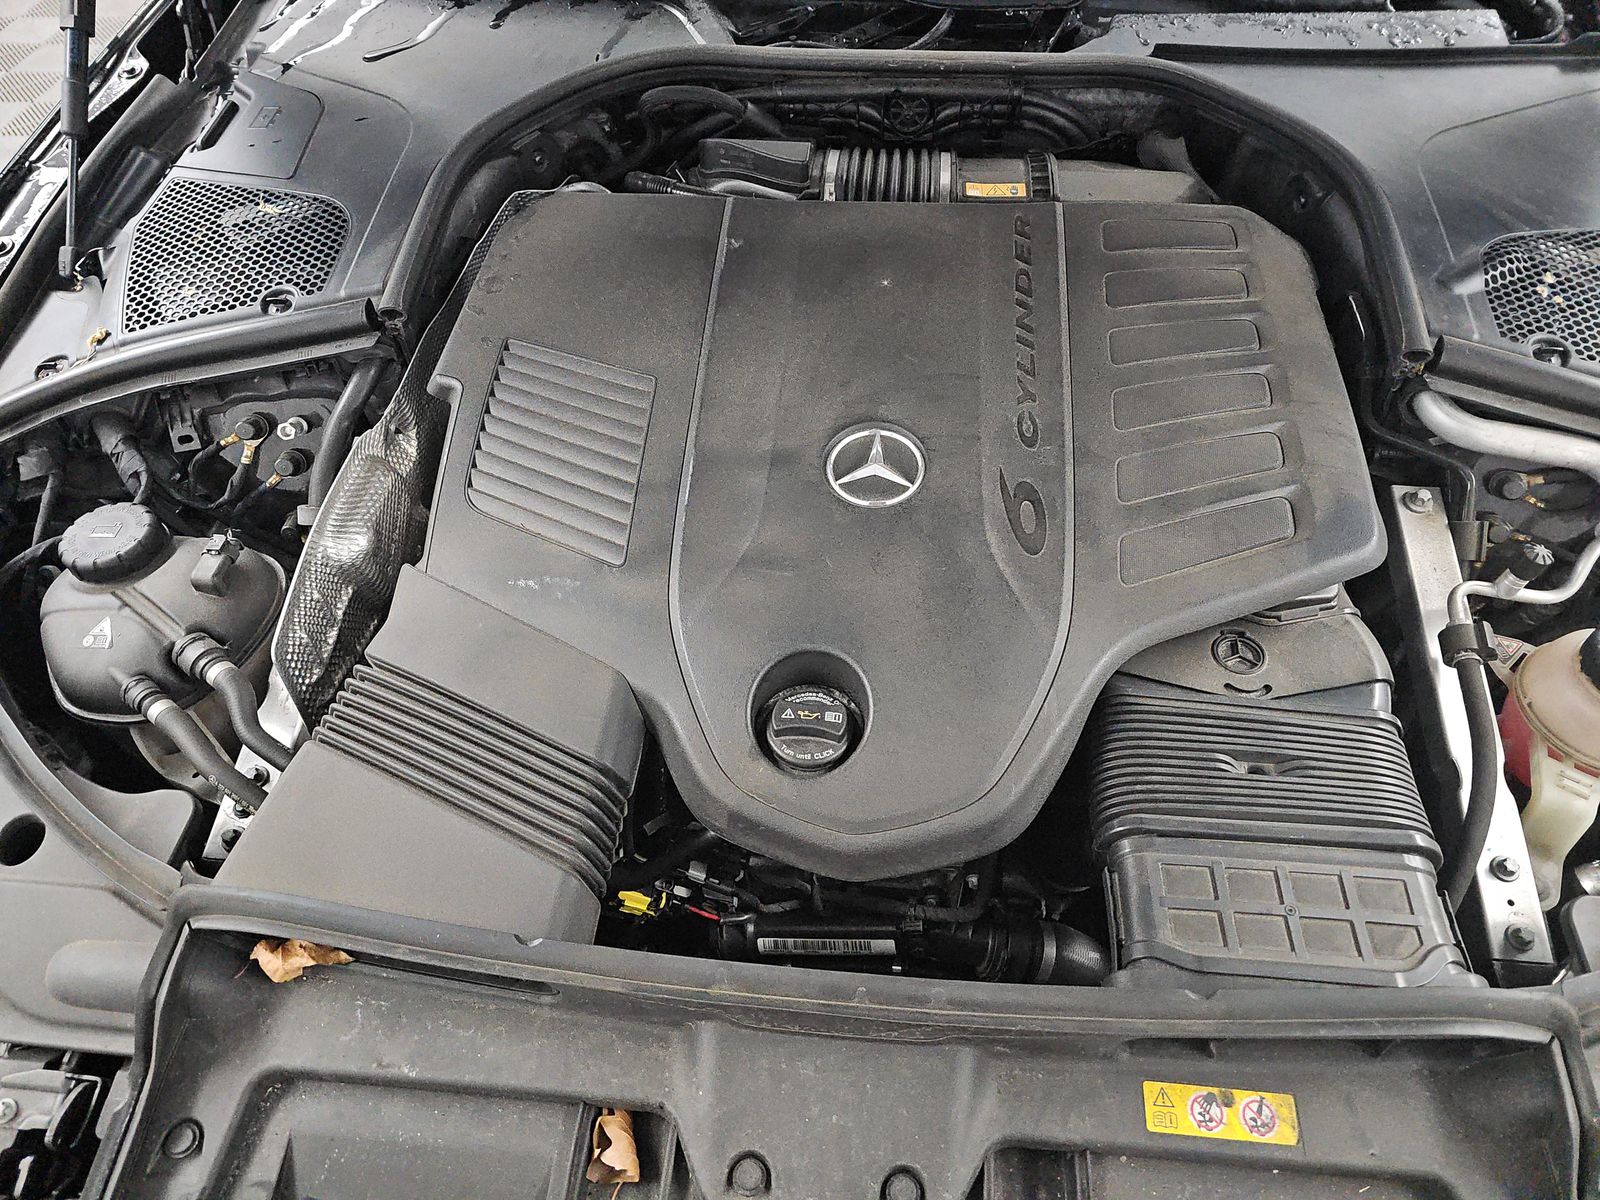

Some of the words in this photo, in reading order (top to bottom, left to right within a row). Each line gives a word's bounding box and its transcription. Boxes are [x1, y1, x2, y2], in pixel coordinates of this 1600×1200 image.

[1012, 213, 1041, 451] CYLINDER
[998, 465, 1048, 557] 6
[780, 744, 795, 757] Turn
[796, 752, 811, 760] until
[813, 748, 835, 760] CLICK
